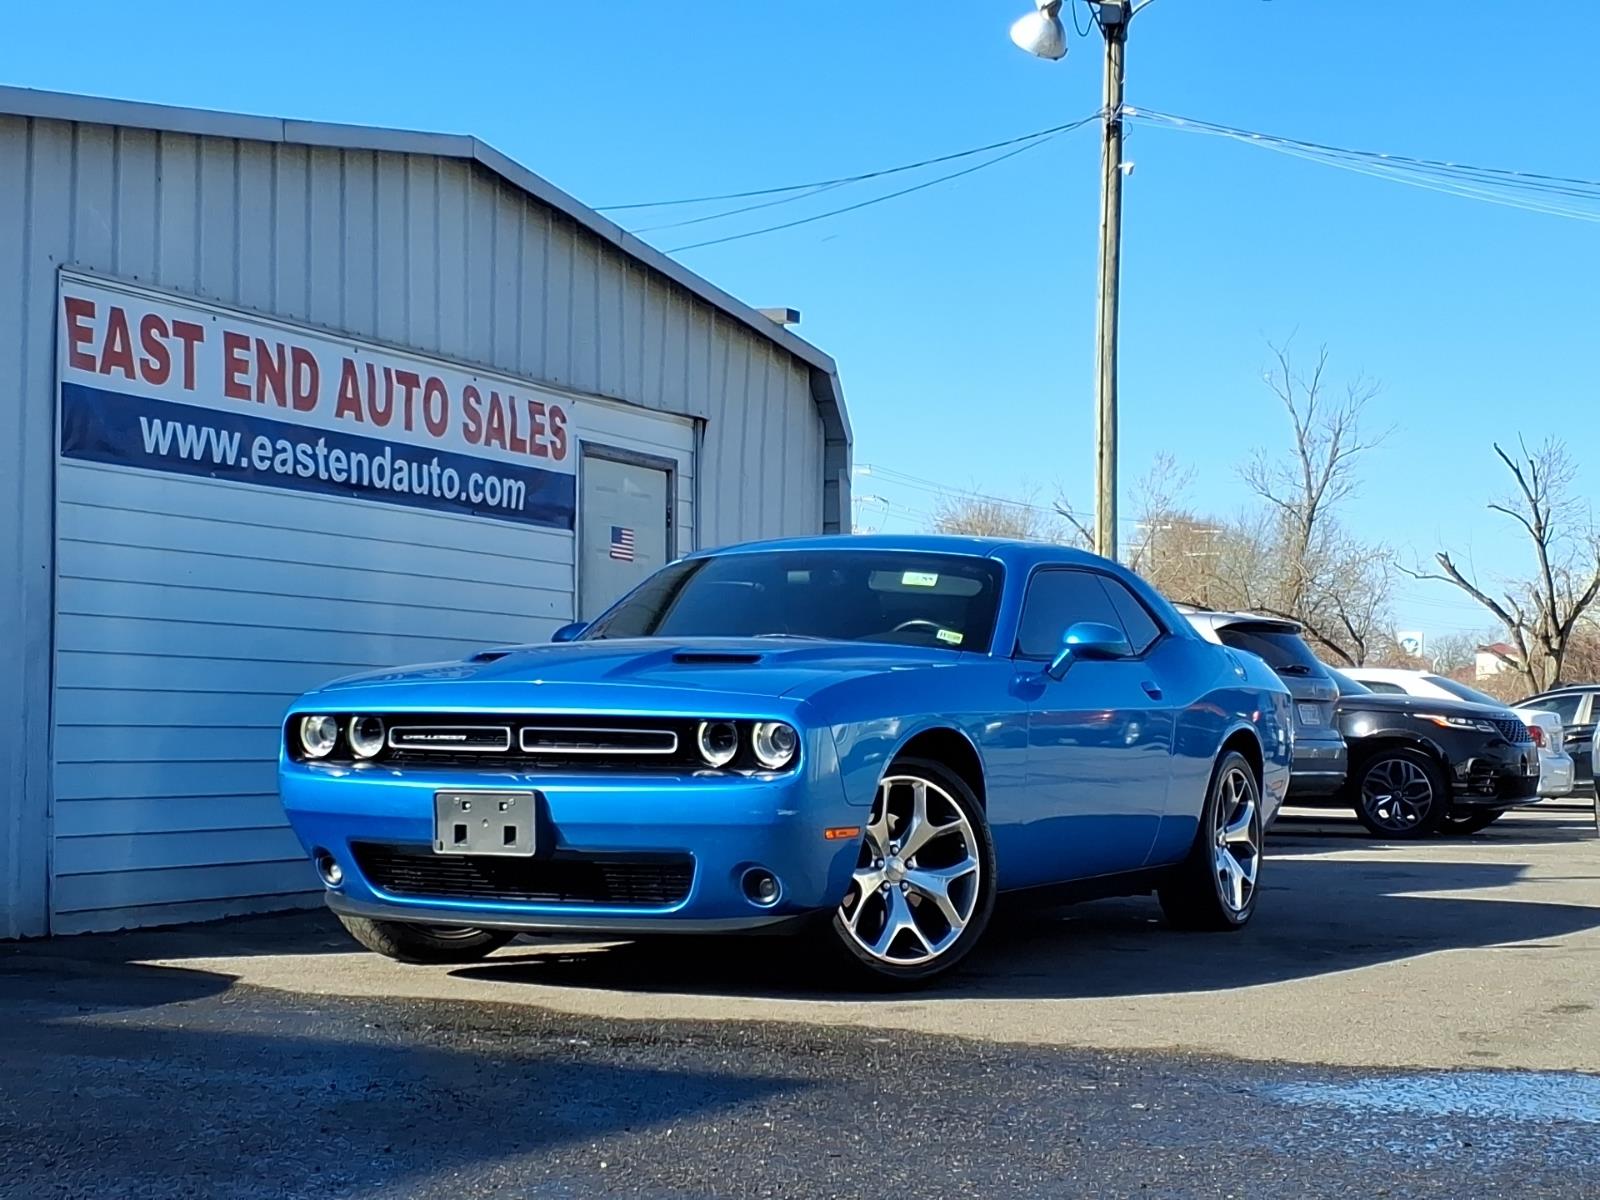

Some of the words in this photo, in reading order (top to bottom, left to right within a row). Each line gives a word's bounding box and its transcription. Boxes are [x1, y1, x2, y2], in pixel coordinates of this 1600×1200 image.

[63, 296, 204, 390] EAST
[223, 331, 320, 412] END
[335, 357, 449, 438] AUTO
[462, 384, 568, 461] SALES
[139, 416, 527, 511] www.eastendauto.com
